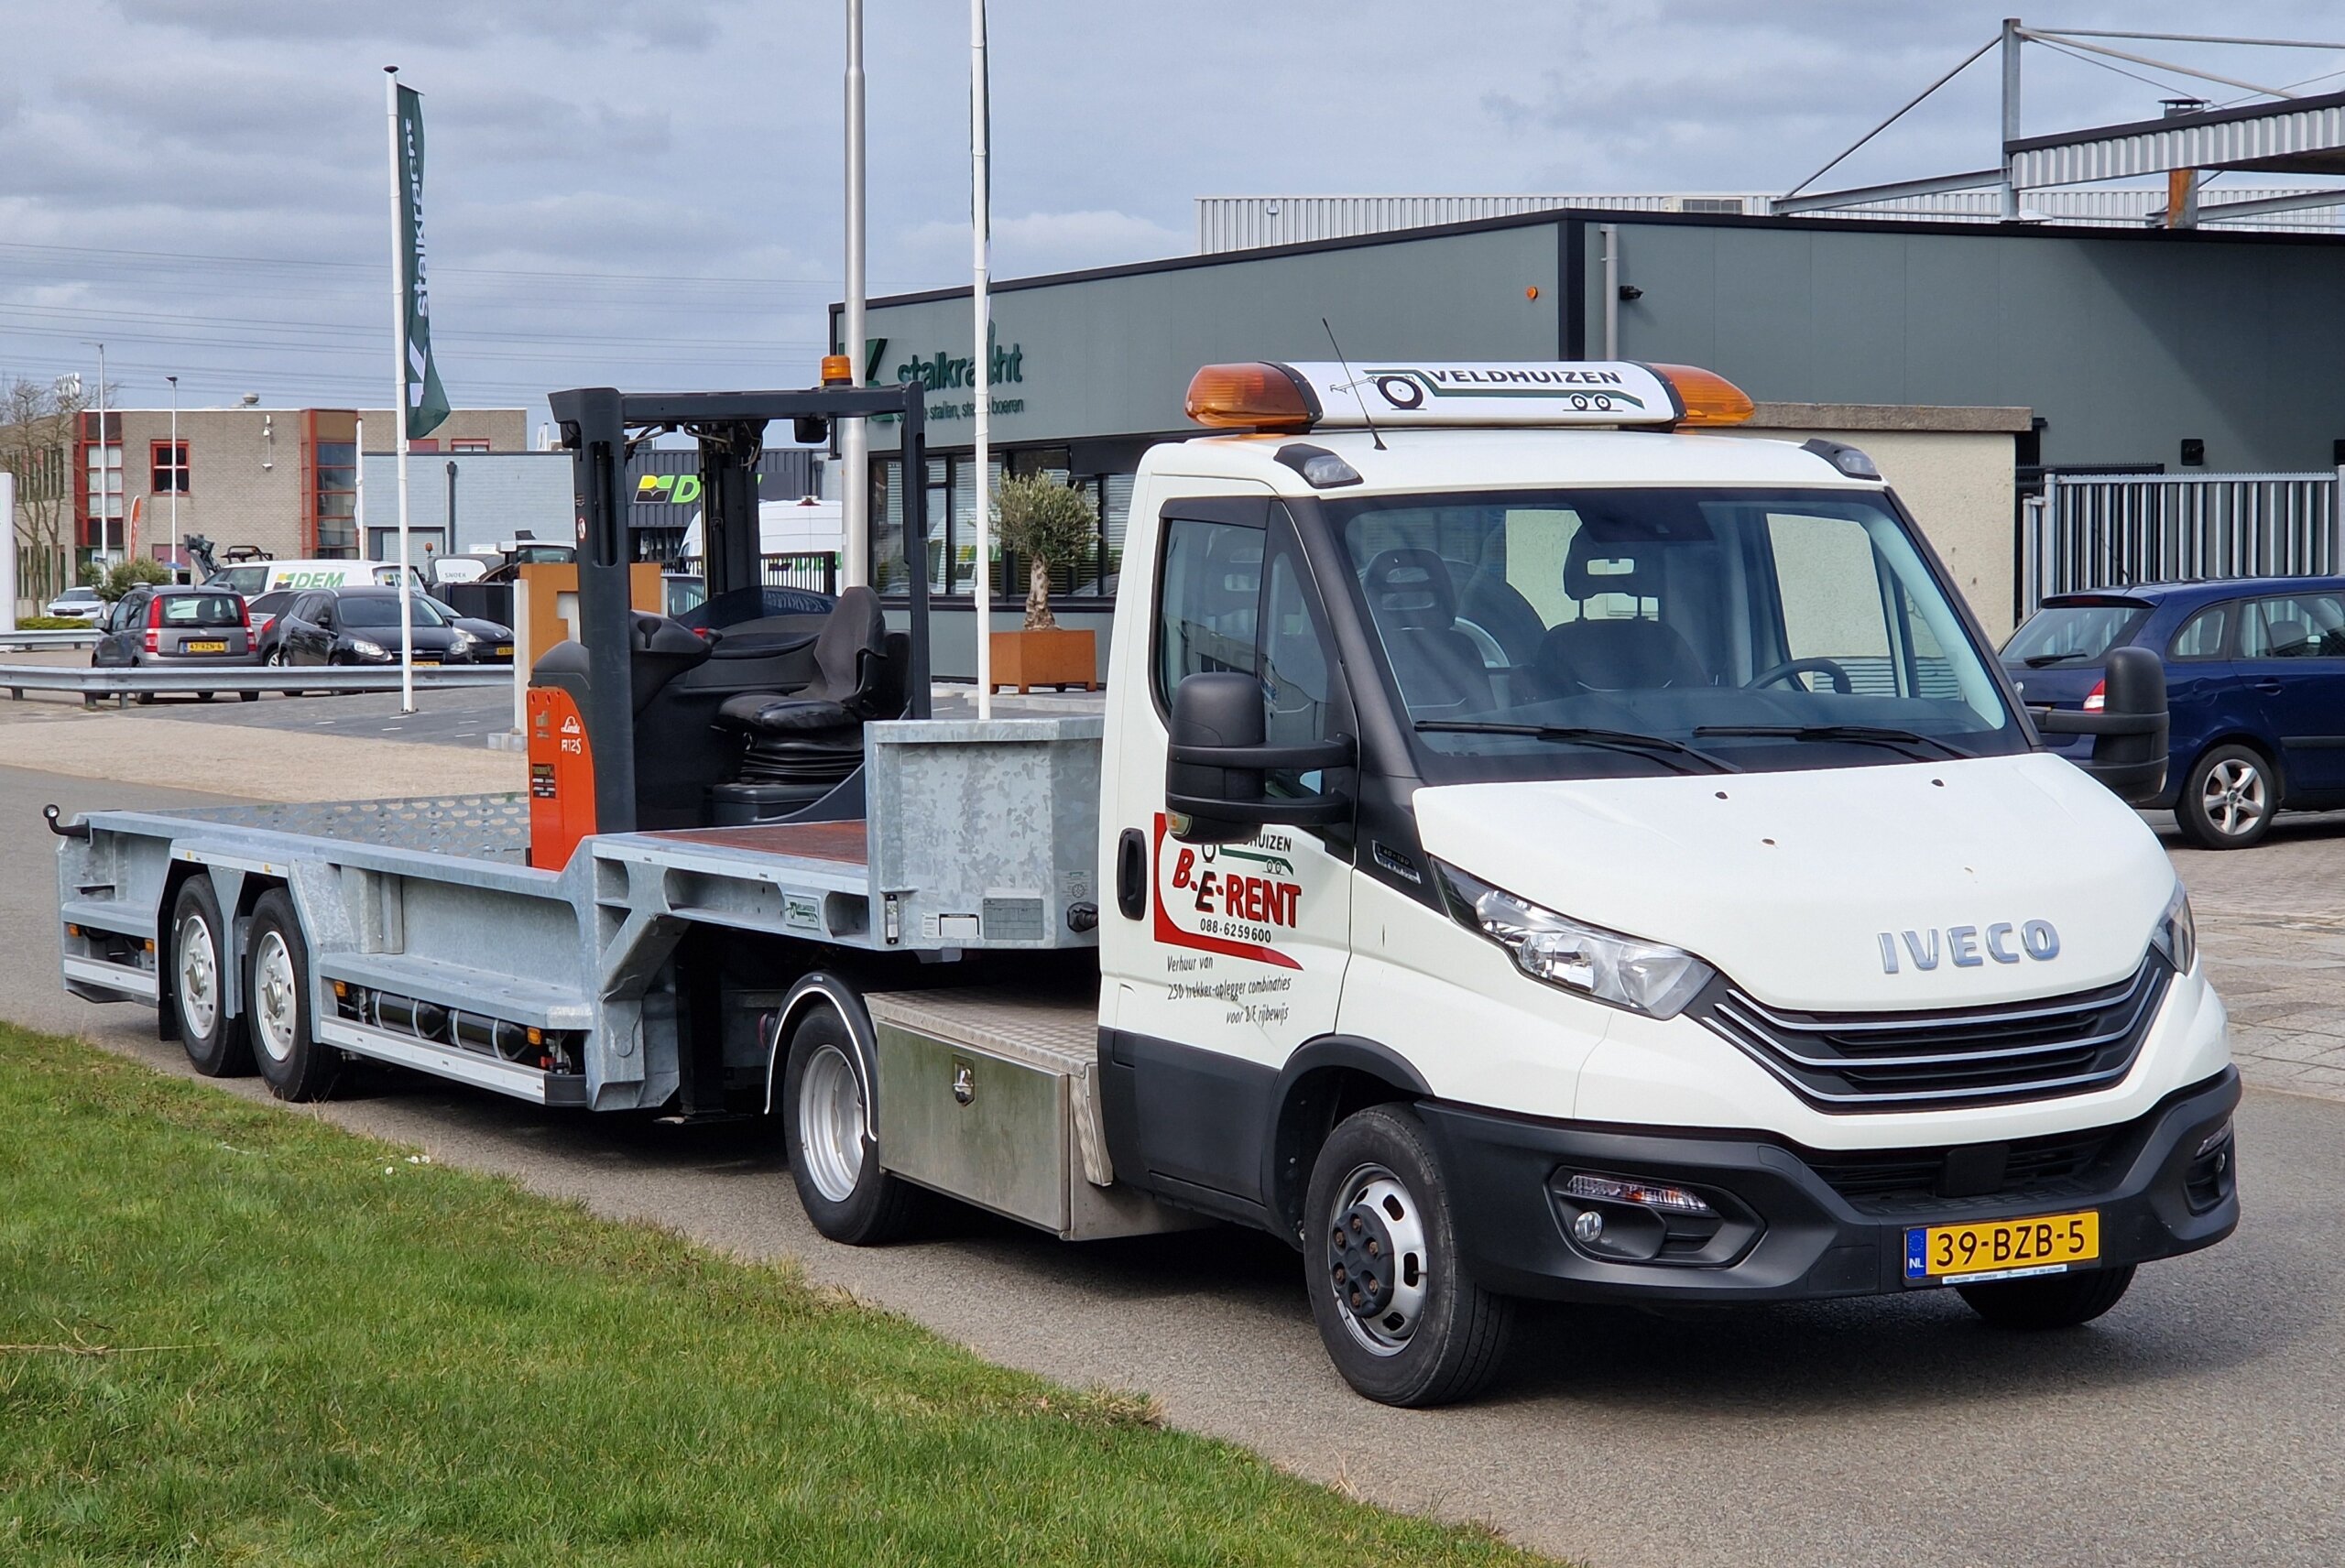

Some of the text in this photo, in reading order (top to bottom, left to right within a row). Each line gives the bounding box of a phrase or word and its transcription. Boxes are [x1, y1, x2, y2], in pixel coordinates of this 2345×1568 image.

[897, 343, 1023, 392] stalkraht
[1427, 370, 1622, 385] VELDHUIZEN
[991, 396, 1024, 414] boeren
[294, 572, 345, 588] DEM
[395, 573, 419, 587] DM
[561, 715, 581, 735] Linde
[1243, 833, 1292, 853] UIZEN
[1878, 919, 2060, 974] IVECO
[1167, 954, 1214, 973] Verhuur van
[1167, 973, 1292, 1002] 250 trekker-oplegger combinaties
[1226, 1010, 1244, 1025] voor
[1258, 1002, 1289, 1029] rijbewijs
[1936, 1219, 2085, 1268] 39-BZB-5
[1909, 1258, 1925, 1269] NL
